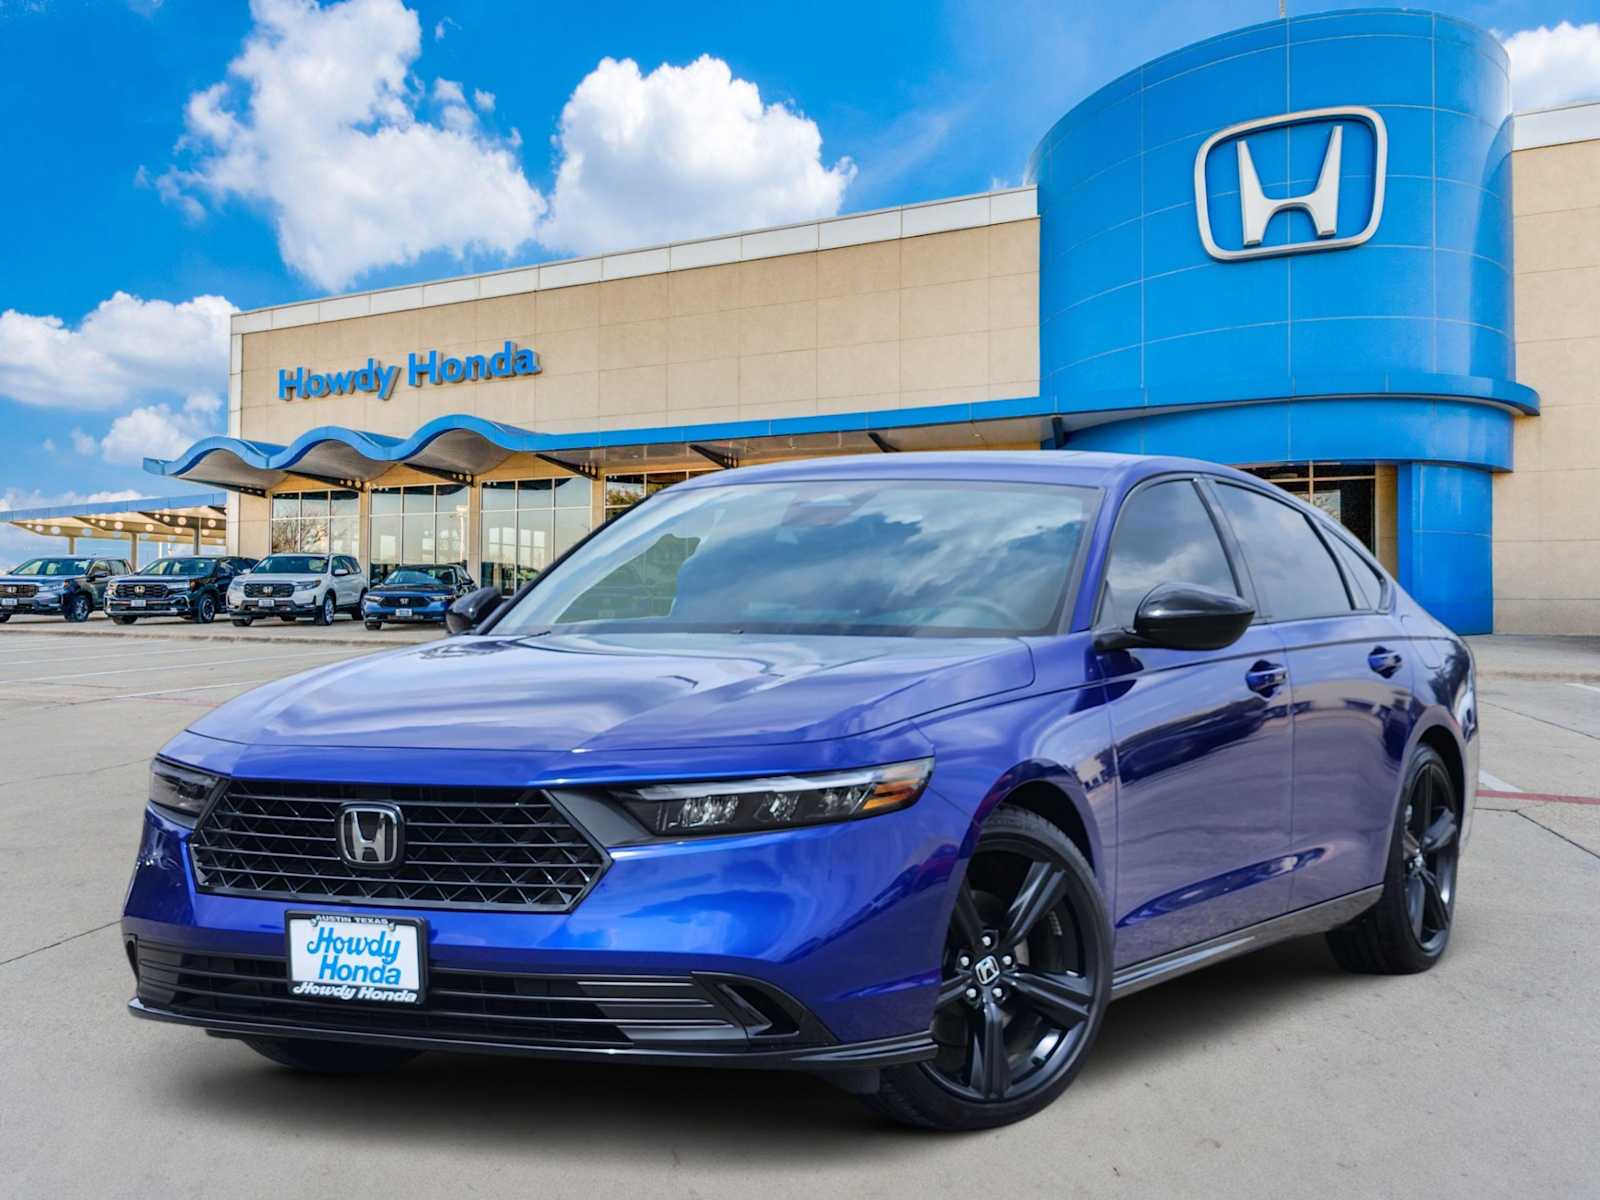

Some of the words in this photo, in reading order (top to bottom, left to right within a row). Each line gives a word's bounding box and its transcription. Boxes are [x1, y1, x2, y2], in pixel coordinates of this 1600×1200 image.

[278, 358, 401, 400] Howdy
[408, 341, 541, 388] Honda
[316, 914, 351, 923] AUSTIN
[354, 917, 389, 926] TEXAS
[307, 927, 401, 965] Howdy
[319, 955, 402, 985] Honda
[293, 982, 357, 1000] Howdy
[358, 986, 418, 1003] Honda
